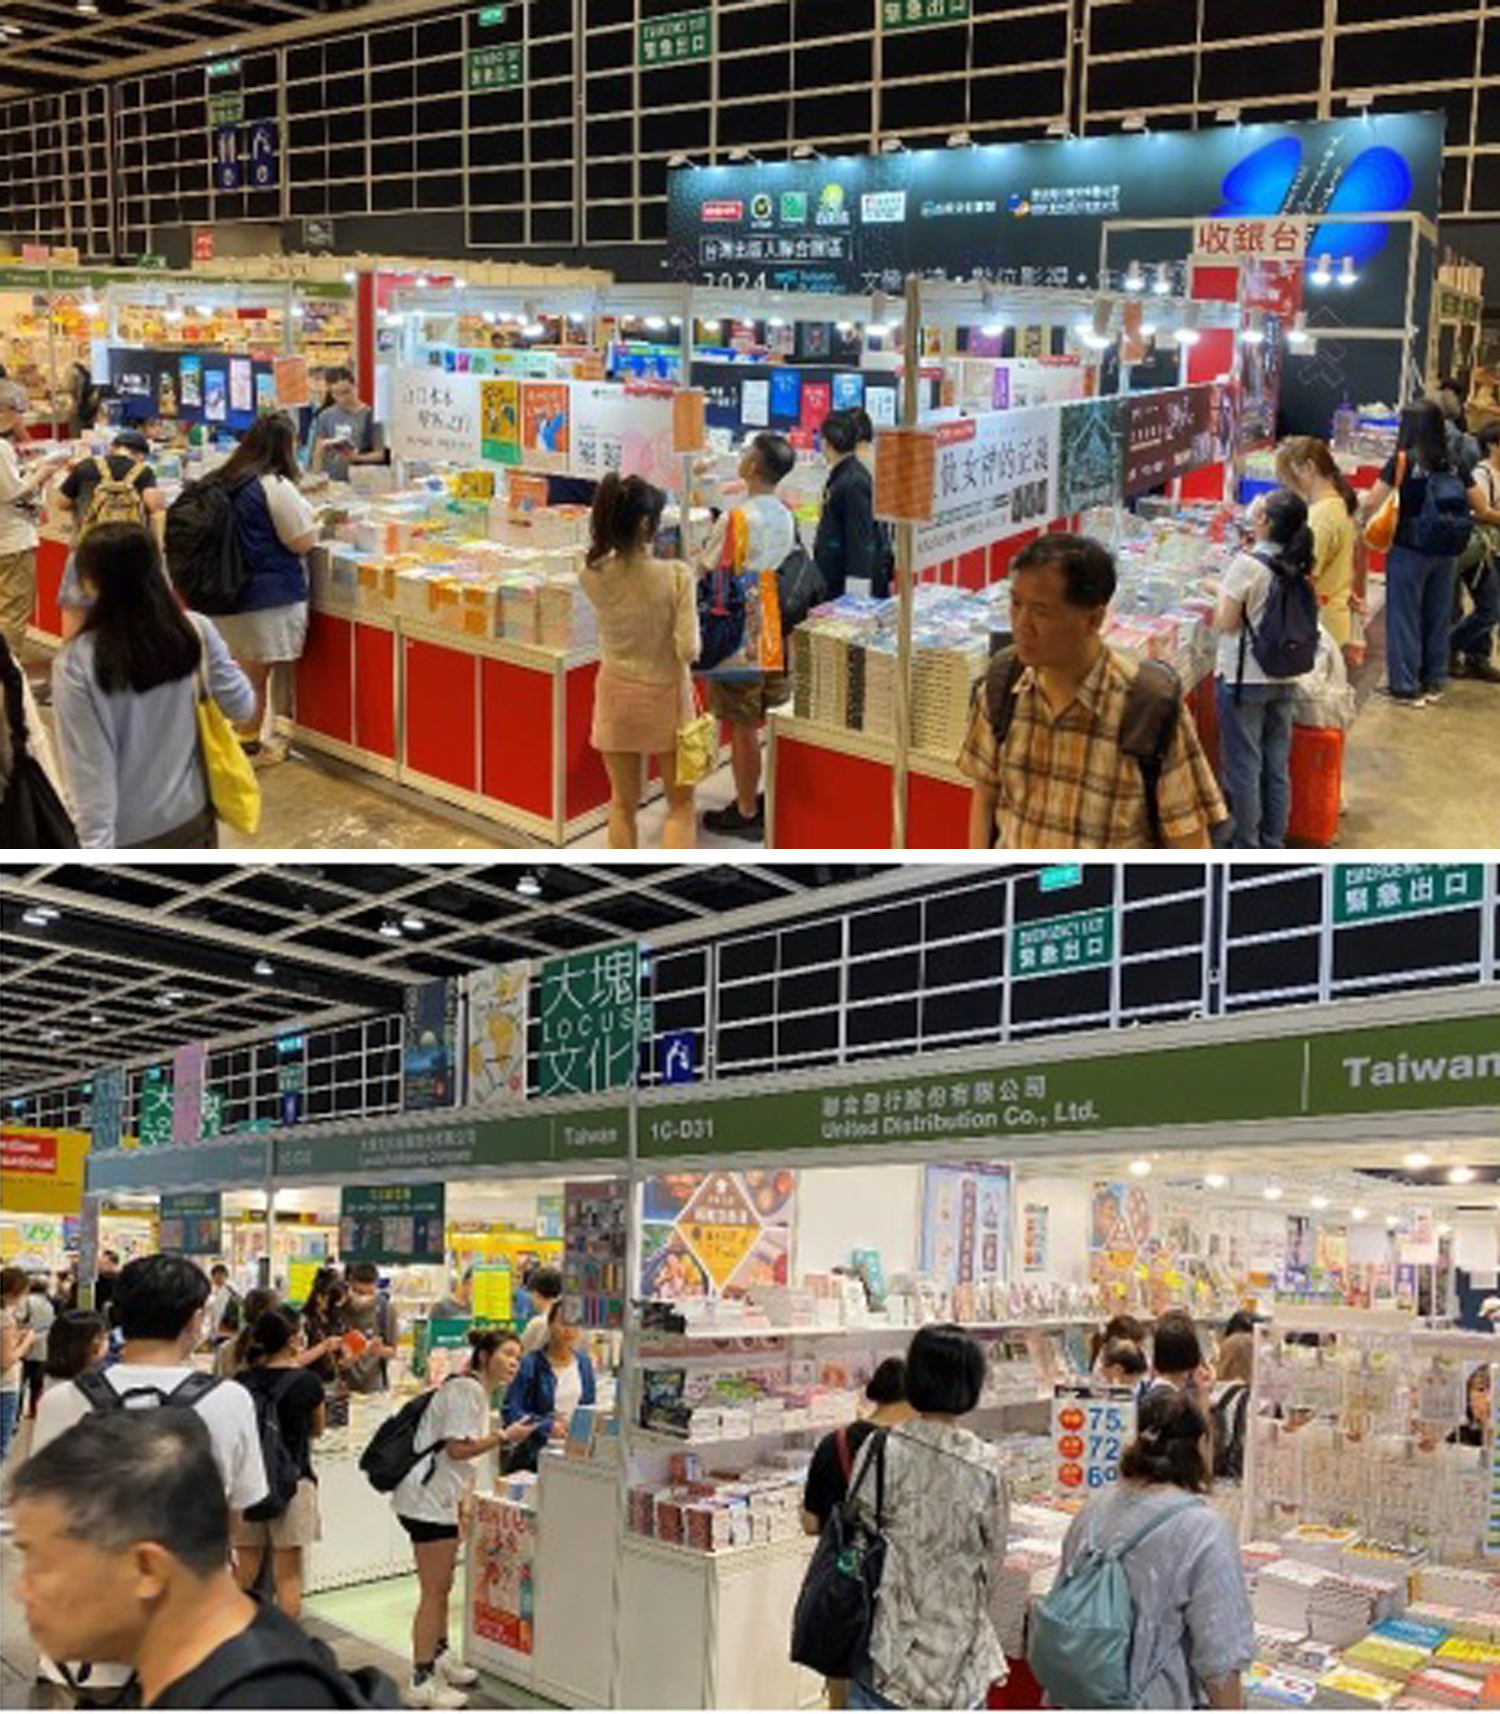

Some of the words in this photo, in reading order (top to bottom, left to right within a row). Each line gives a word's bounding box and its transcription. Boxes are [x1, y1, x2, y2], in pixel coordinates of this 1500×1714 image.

[1200, 222, 1299, 253] 收銀台
[1346, 873, 1467, 914] 緊急出口
[1020, 938, 1104, 969] 緊急出口
[546, 951, 635, 1018] 大塊
[543, 1010, 634, 1043] LOCUS
[540, 1040, 633, 1094] 文化
[1342, 1051, 1500, 1088] Taiwan
[822, 1076, 1046, 1117] 聯合發行股份有限公司
[563, 1127, 618, 1146] Taiwan
[651, 1119, 714, 1141] 1C-D31
[822, 1119, 878, 1138] United
[883, 1109, 997, 1135] Distribution
[1003, 1105, 1048, 1128] Co.,
[1054, 1100, 1099, 1122] Ltd.
[1089, 1436, 1119, 1460] 72
